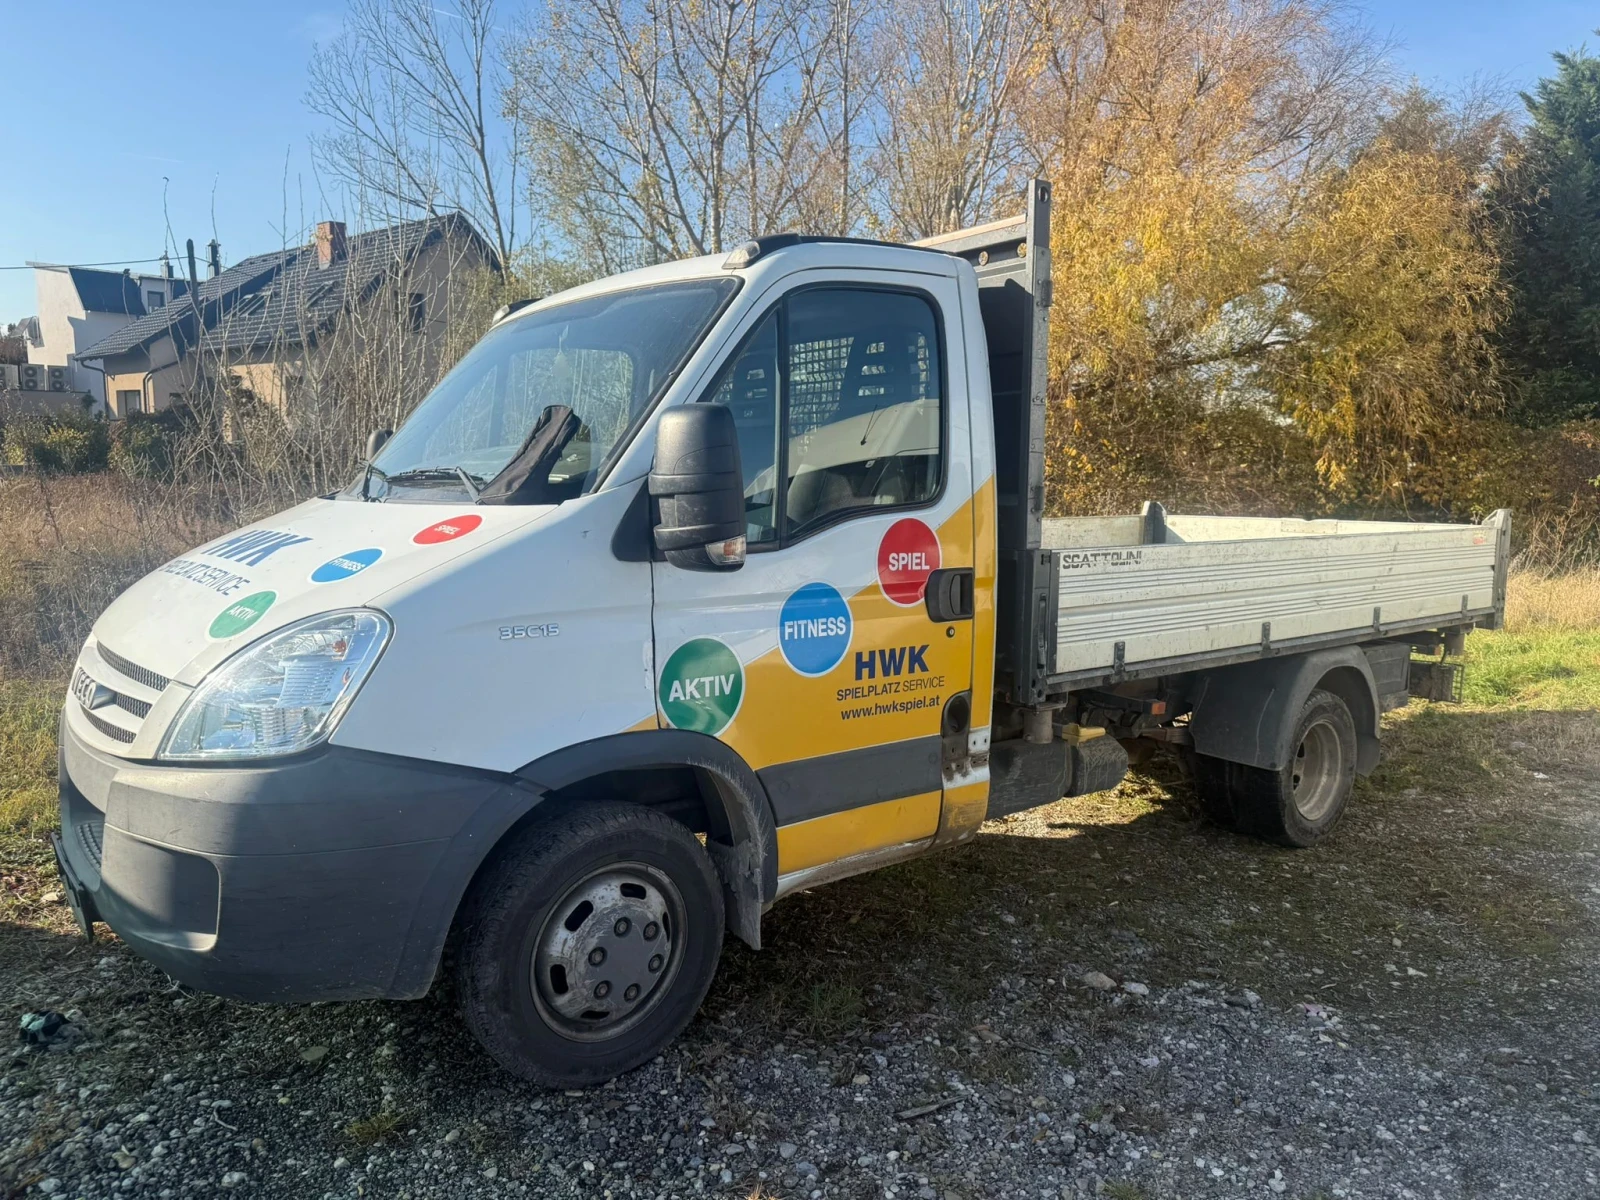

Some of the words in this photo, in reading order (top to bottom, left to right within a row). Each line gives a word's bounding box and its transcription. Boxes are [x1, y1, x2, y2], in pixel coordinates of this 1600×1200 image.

[200, 530, 313, 567] HWK
[888, 552, 930, 571] SPIEL
[1062, 550, 1142, 570] SCATTOLINI
[192, 567, 251, 596] SERVICE
[226, 604, 258, 621] AKTIV
[499, 623, 560, 641] 35C15
[784, 616, 847, 641] FITNESS
[855, 644, 930, 681] HWK
[668, 673, 735, 703] AKTIV
[836, 681, 901, 702] SPIELPLATZ
[902, 675, 945, 692] SERVICE
[841, 694, 940, 721] www.hwkspiel.at
